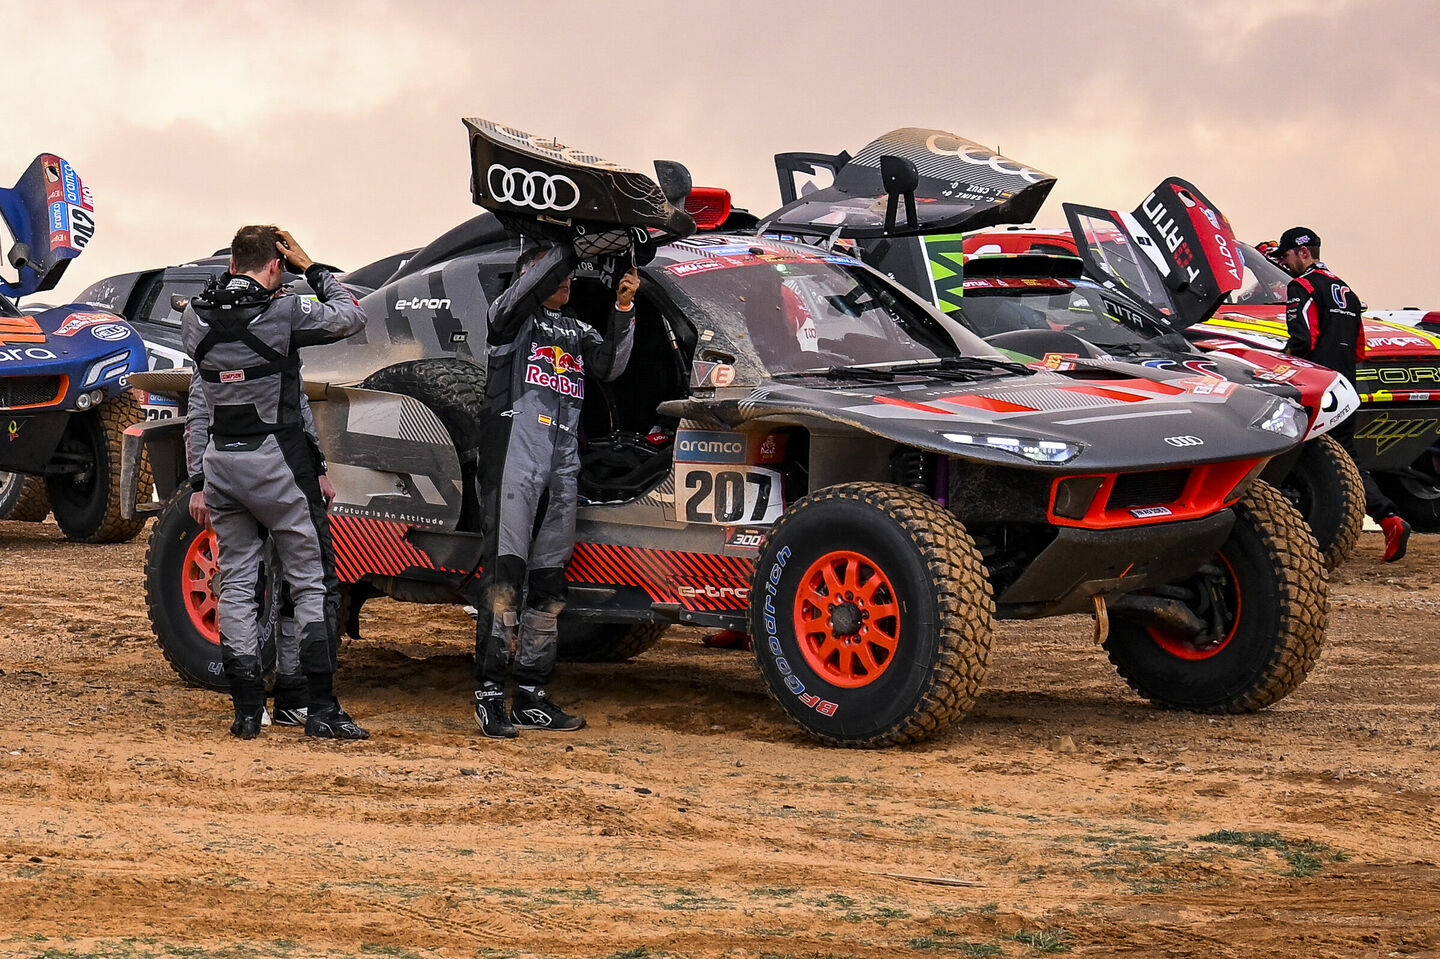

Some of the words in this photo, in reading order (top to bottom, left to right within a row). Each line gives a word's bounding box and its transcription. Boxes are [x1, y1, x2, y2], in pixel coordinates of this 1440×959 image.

[954, 192, 984, 201] SAINZ
[966, 184, 990, 195] CRUZ
[1216, 233, 1241, 281] ALDO
[394, 296, 452, 310] e-tron
[525, 363, 560, 393] Red
[679, 440, 743, 453] aramco
[685, 470, 772, 523] 207
[332, 506, 369, 516] #Future
[400, 513, 444, 525] Attitude
[678, 585, 750, 599] e-tro
[765, 545, 839, 718] BFGoodrich
